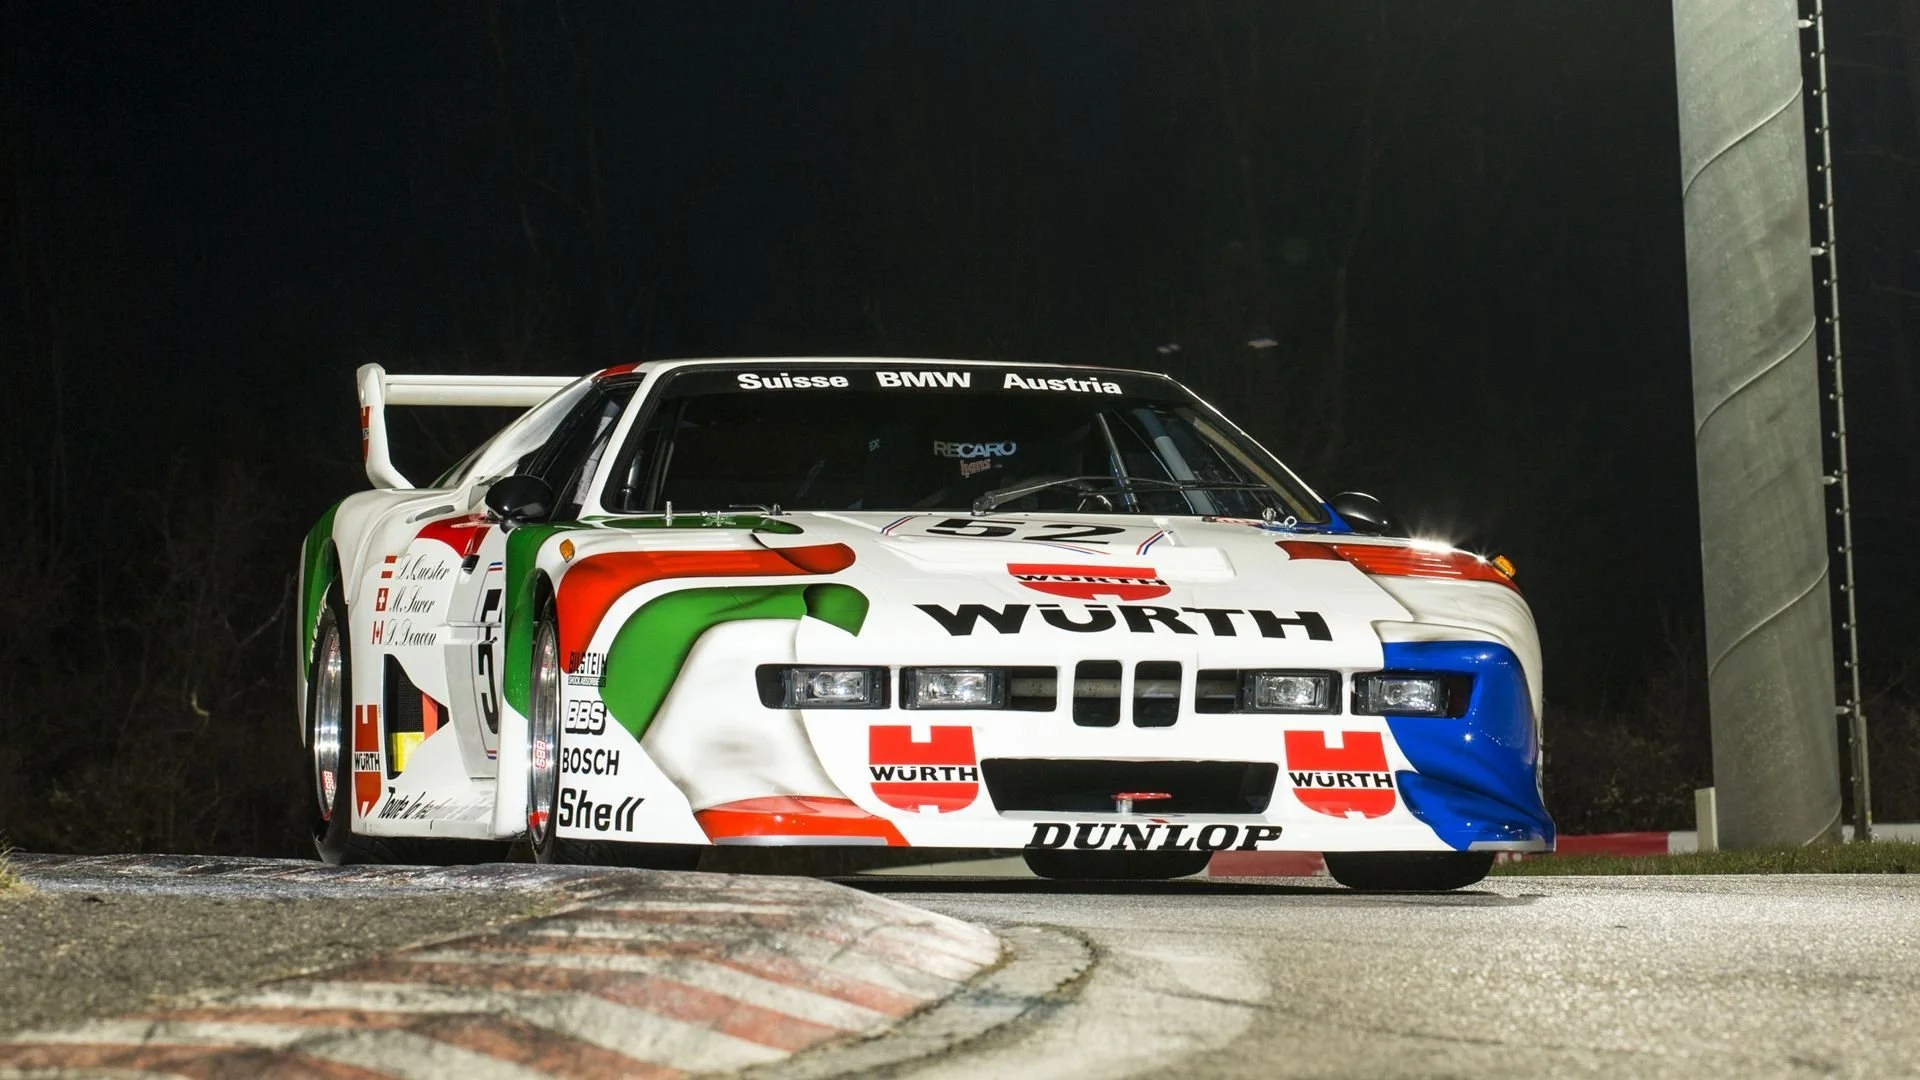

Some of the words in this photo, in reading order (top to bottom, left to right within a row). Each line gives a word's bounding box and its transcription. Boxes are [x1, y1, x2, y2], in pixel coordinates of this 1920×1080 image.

[737, 373, 849, 390] Suisse
[876, 371, 971, 388] BMW
[1003, 373, 1122, 395] Austria
[934, 440, 1016, 458] RECARO
[926, 519, 1126, 545] 52
[913, 603, 1333, 641] WÜRTH
[569, 652, 607, 675] BILSTEIN
[565, 700, 607, 735] BBS
[354, 753, 380, 770] WÜRTH
[535, 740, 547, 769] BBS
[562, 747, 620, 775] BOSCH
[869, 766, 978, 781] WÜRTH
[1288, 772, 1394, 788] WÜRTH
[559, 788, 645, 832] Shell
[1024, 822, 1283, 851] DUNLOP
